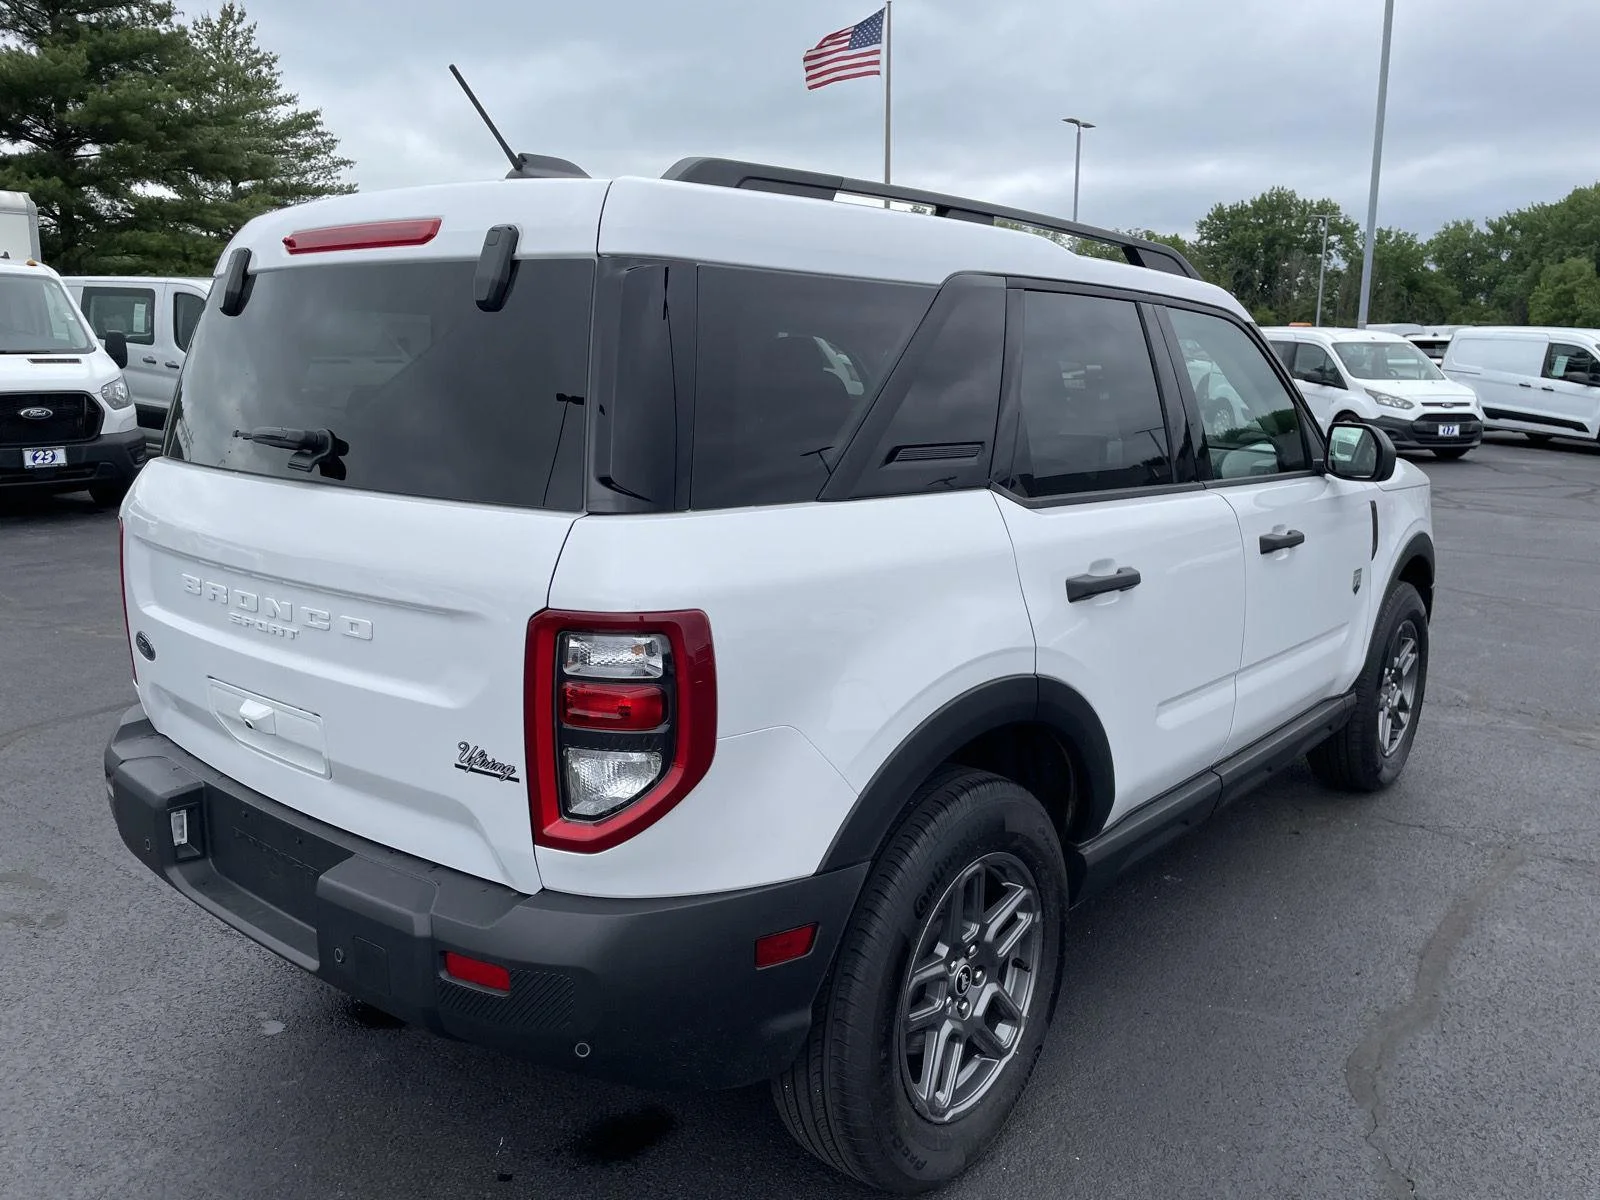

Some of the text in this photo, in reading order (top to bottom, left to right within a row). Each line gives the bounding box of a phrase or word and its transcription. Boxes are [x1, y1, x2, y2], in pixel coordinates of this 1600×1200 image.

[28, 409, 47, 417] Ford
[34, 450, 54, 465] 23
[182, 573, 373, 641] BRONCO
[228, 612, 299, 640] SPORT
[457, 741, 517, 781] Uftring
